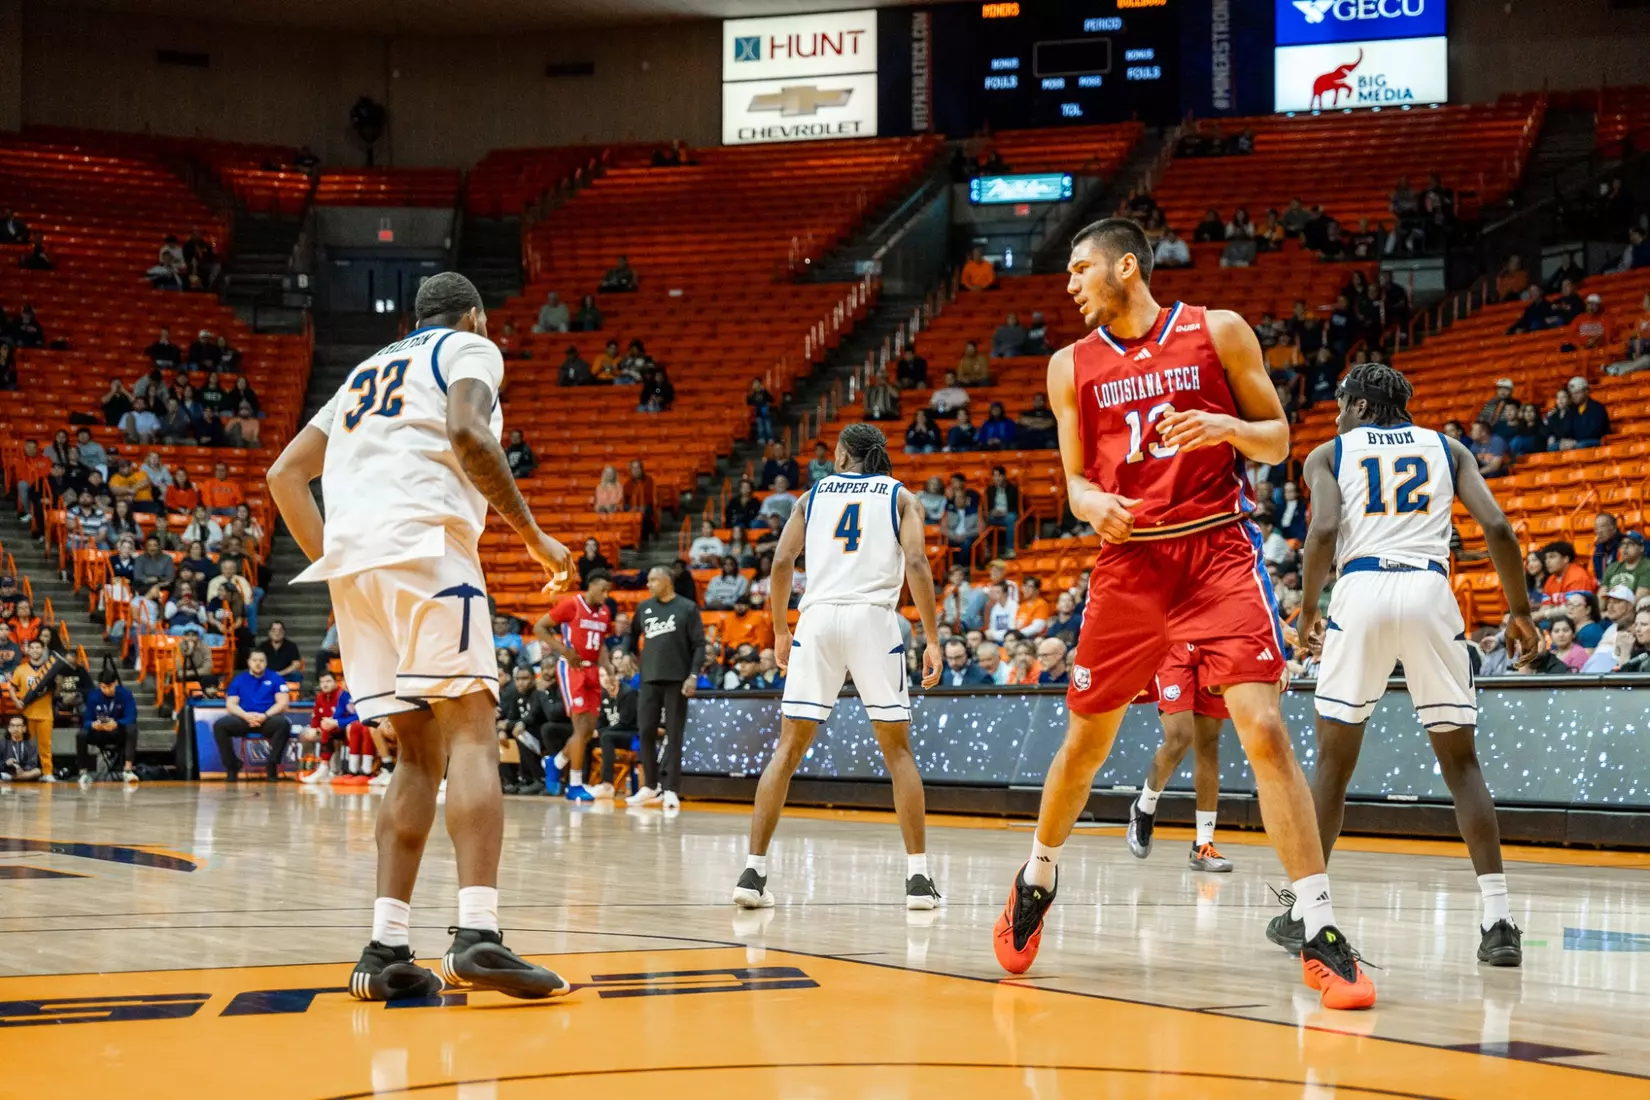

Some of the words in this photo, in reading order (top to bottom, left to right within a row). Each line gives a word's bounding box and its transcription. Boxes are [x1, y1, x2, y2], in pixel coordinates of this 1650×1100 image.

[1332, 0, 1425, 21] GECU
[1084, 17, 1122, 32] PERIOD
[769, 30, 866, 60] HUNT
[984, 75, 1018, 90] FOULS
[1127, 66, 1161, 80] FOULS
[1358, 74, 1387, 88] BIG
[1358, 88, 1413, 102] MEDIA
[738, 120, 863, 141] CHEVROLET
[343, 356, 412, 433] 32
[1094, 371, 1164, 409] LOUISIANA
[1164, 366, 1200, 392] TECH
[1367, 431, 1415, 445] BYNUM
[817, 482, 869, 494] CAMPER
[870, 482, 889, 496] JR.
[1358, 453, 1432, 517] 12
[832, 501, 863, 555] 4
[585, 631, 600, 651] 14
